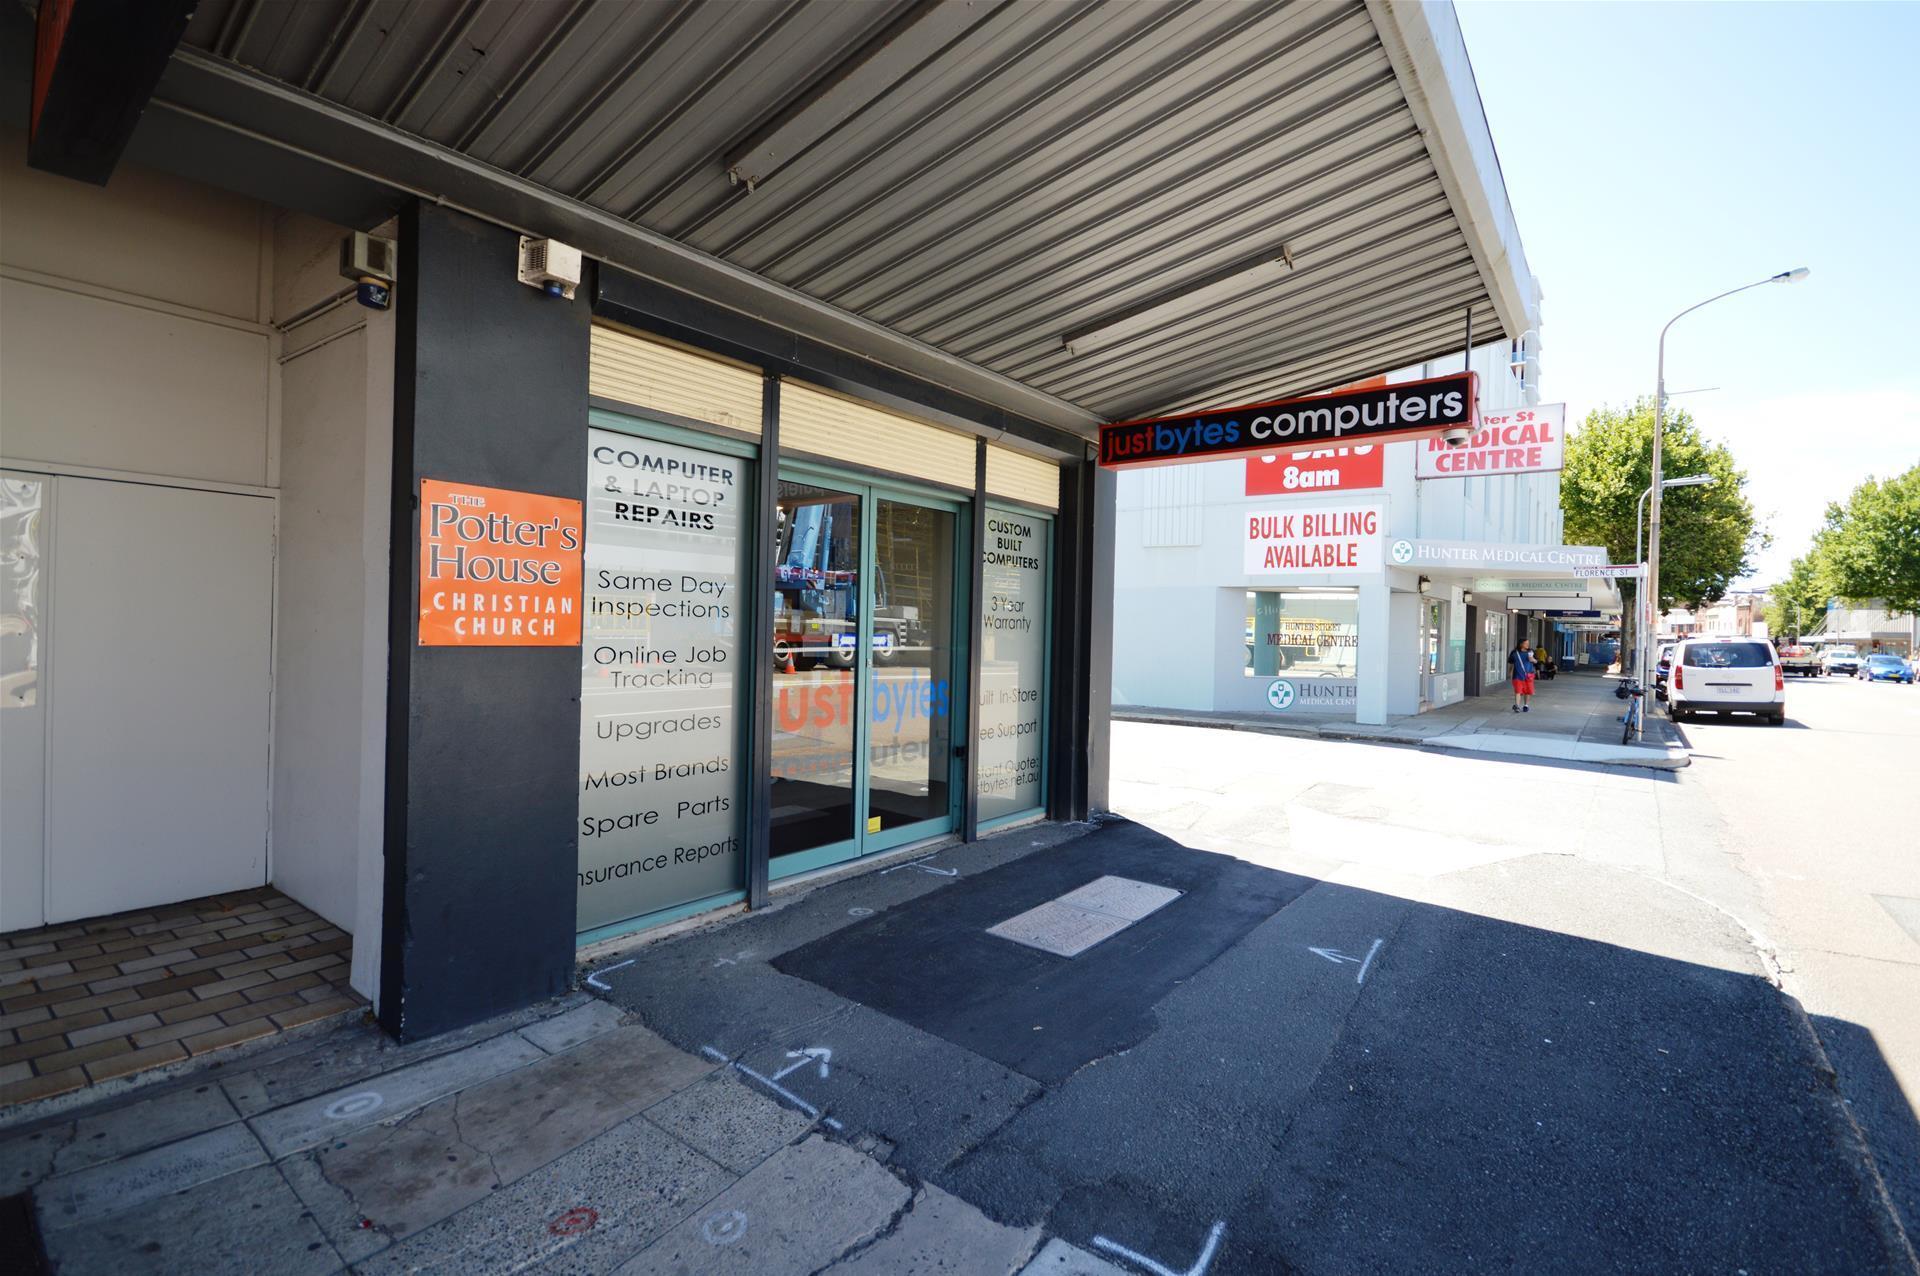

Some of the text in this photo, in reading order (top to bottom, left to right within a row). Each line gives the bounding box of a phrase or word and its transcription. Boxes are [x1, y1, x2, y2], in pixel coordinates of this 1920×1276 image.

[1105, 416, 1240, 461] justbytes
[1250, 389, 1464, 437] computers
[1515, 410, 1535, 422] St
[1428, 422, 1555, 452] MDICAL
[593, 446, 734, 486] COMPUTER
[1435, 447, 1542, 473] CENTRE
[1282, 466, 1340, 490] 8am
[448, 493, 487, 508] THE
[604, 475, 725, 507] & LAPTOP
[428, 502, 578, 550] Potter's
[615, 502, 714, 530] REPAIRS
[1249, 510, 1377, 539] BULK BILLING
[988, 519, 1032, 538] CUSTOM
[997, 537, 1023, 552] BUILT
[1263, 542, 1358, 569] AVAILABLE
[1417, 544, 1601, 565] HUNTER MEDICAL CENTRE
[428, 543, 561, 585] House
[1575, 568, 1629, 577] FLORENCE ST
[597, 570, 727, 598] Same Day
[433, 591, 572, 614] CHRISTIAN
[592, 596, 730, 620] Inspections
[991, 596, 1025, 613] 3 Year
[454, 616, 555, 636] CHURCH
[984, 613, 1032, 633] Warranty
[1285, 622, 1341, 632] HUNTER STREET
[1267, 633, 1359, 647] MEDICAL CENTRE
[594, 646, 727, 665] Online Job
[610, 669, 713, 689] Tracking
[872, 668, 948, 733] bytes
[597, 714, 722, 742] Upgrades
[997, 718, 1038, 739] Support
[585, 756, 729, 791] Most Brands
[582, 795, 730, 838] Spare Parts
[674, 836, 739, 865] Reports
